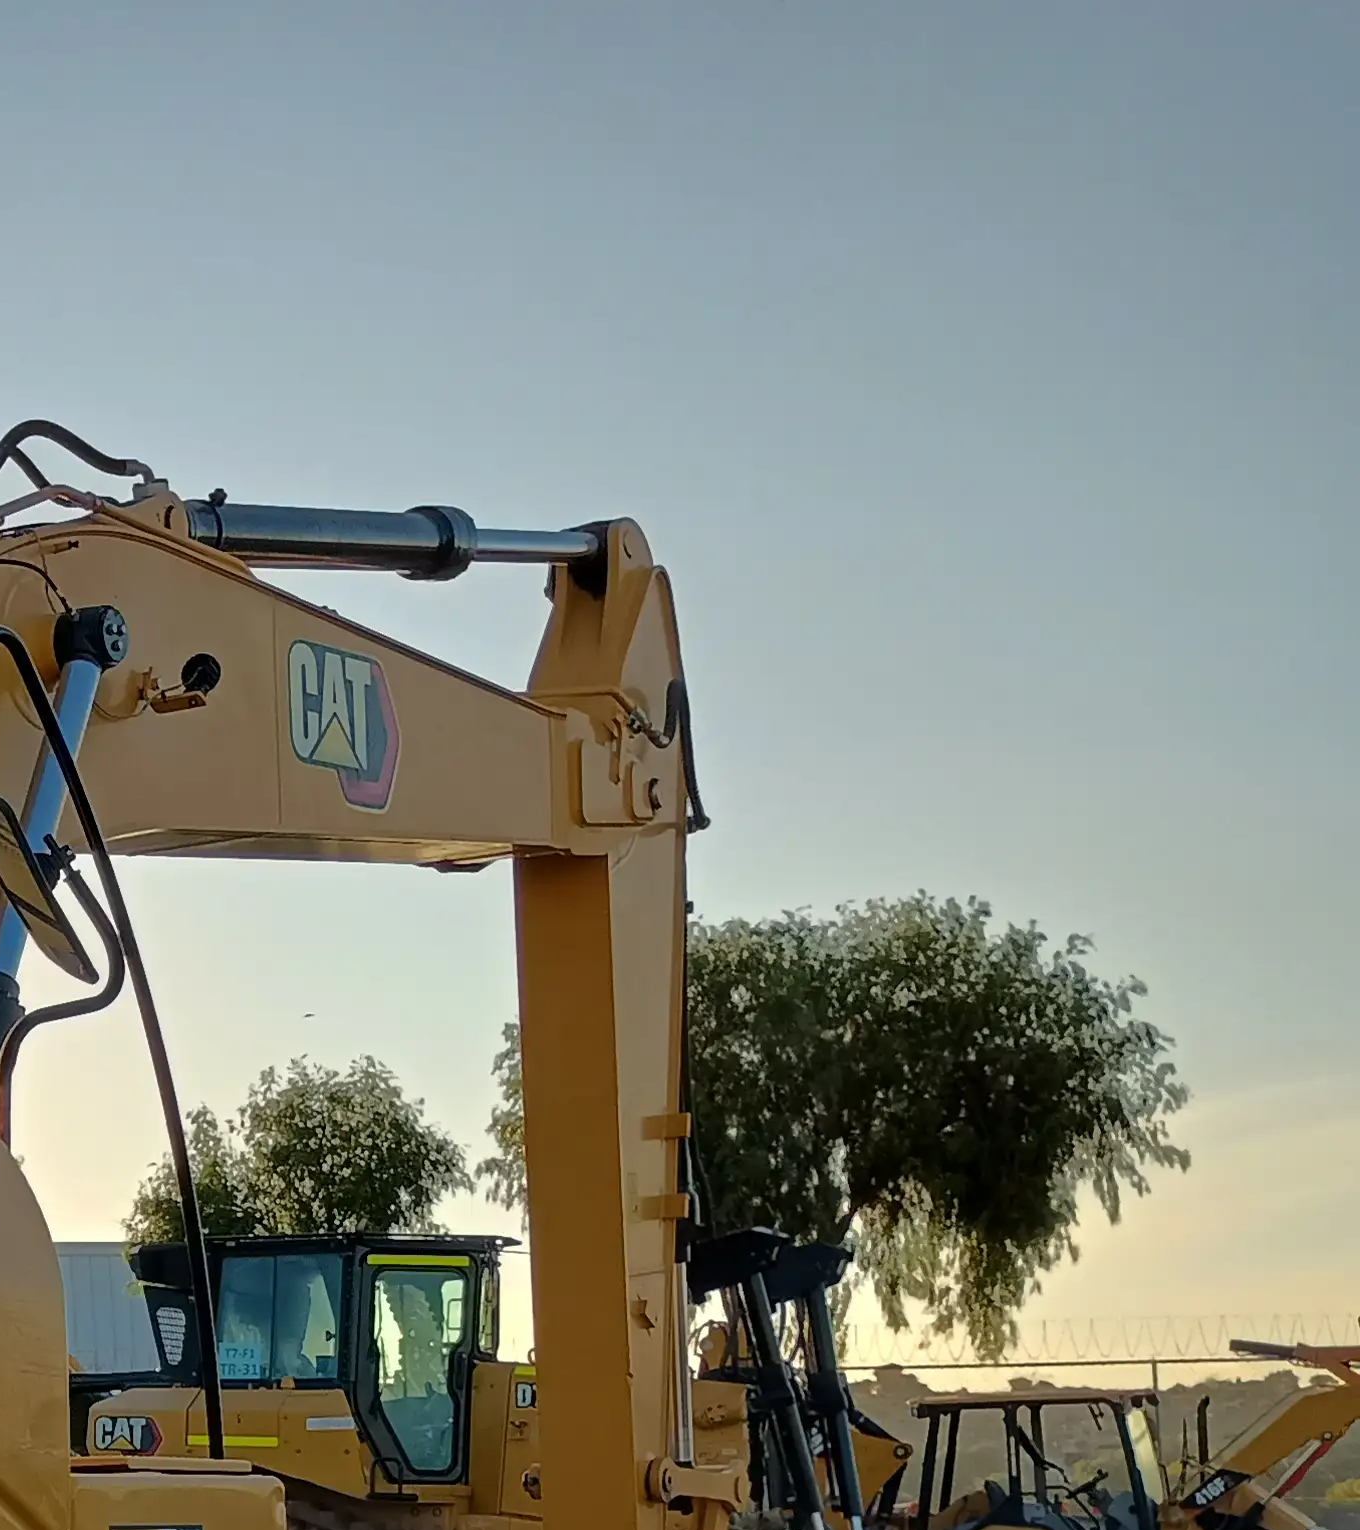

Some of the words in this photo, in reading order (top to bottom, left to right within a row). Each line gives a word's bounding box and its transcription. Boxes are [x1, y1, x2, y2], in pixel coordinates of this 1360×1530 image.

[290, 642, 372, 771] CAT
[220, 1363, 258, 1376] TR-31
[516, 1383, 536, 1407] D
[95, 1416, 146, 1450] CAT
